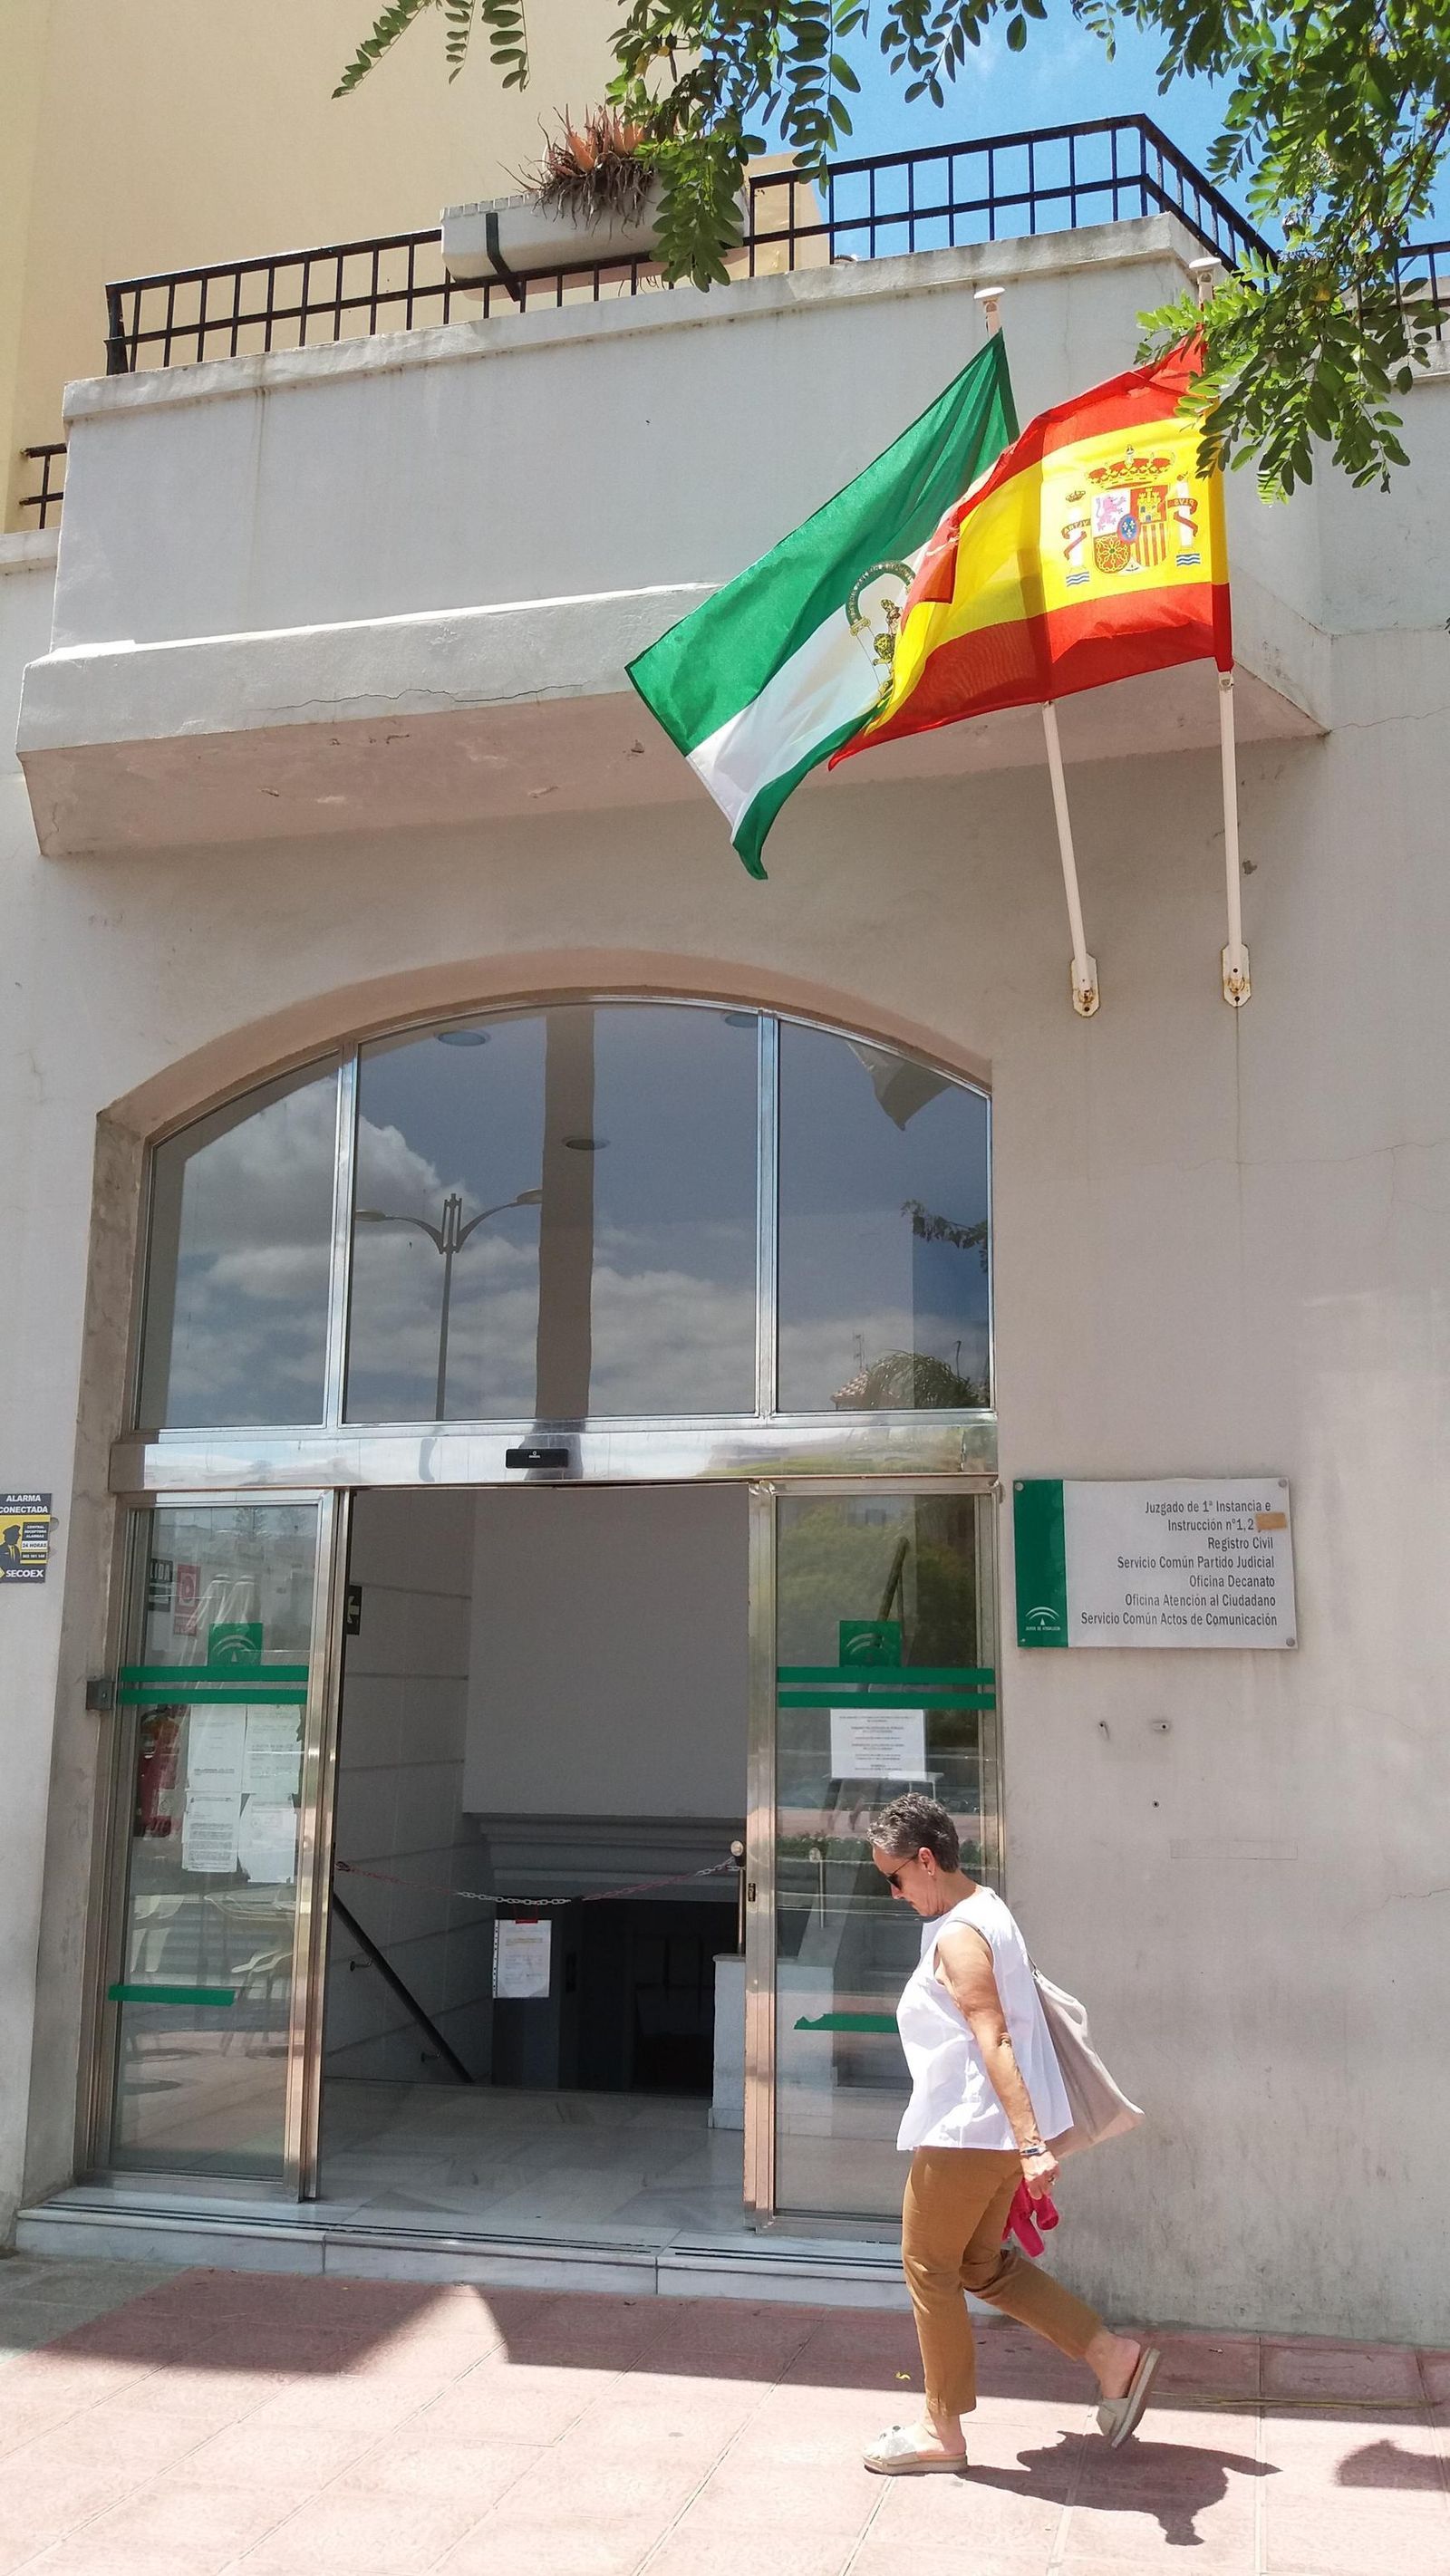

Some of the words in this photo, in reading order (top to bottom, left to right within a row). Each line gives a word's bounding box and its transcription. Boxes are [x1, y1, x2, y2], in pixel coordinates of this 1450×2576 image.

[0, 1506, 48, 1514] CONECTADA
[1146, 1500, 1184, 1516] Juzgado
[1187, 1500, 1199, 1512] de
[1216, 1500, 1262, 1512] Instancia
[1264, 1501, 1271, 1511] e
[1168, 1518, 1223, 1531] Instrucción
[1207, 1537, 1250, 1551] Registro
[1252, 1537, 1274, 1549] Civil
[1117, 1556, 1156, 1569] Servicio
[1159, 1555, 1194, 1569] Común
[1197, 1555, 1234, 1568] Partido
[1236, 1554, 1275, 1568] Judicial
[5, 1569, 44, 1577] SECOEX
[1189, 1574, 1224, 1587] Oficina
[1228, 1574, 1275, 1587] Decanato
[1125, 1593, 1160, 1606] Oficina
[1163, 1593, 1207, 1606] Atención
[1210, 1593, 1219, 1606] al
[1223, 1593, 1276, 1606] Ciudadano
[1081, 1611, 1120, 1625] Servicio
[1123, 1612, 1157, 1625] Común
[1161, 1613, 1187, 1626] Actos
[1190, 1613, 1203, 1626] de
[1205, 1613, 1278, 1626] Comunicación
